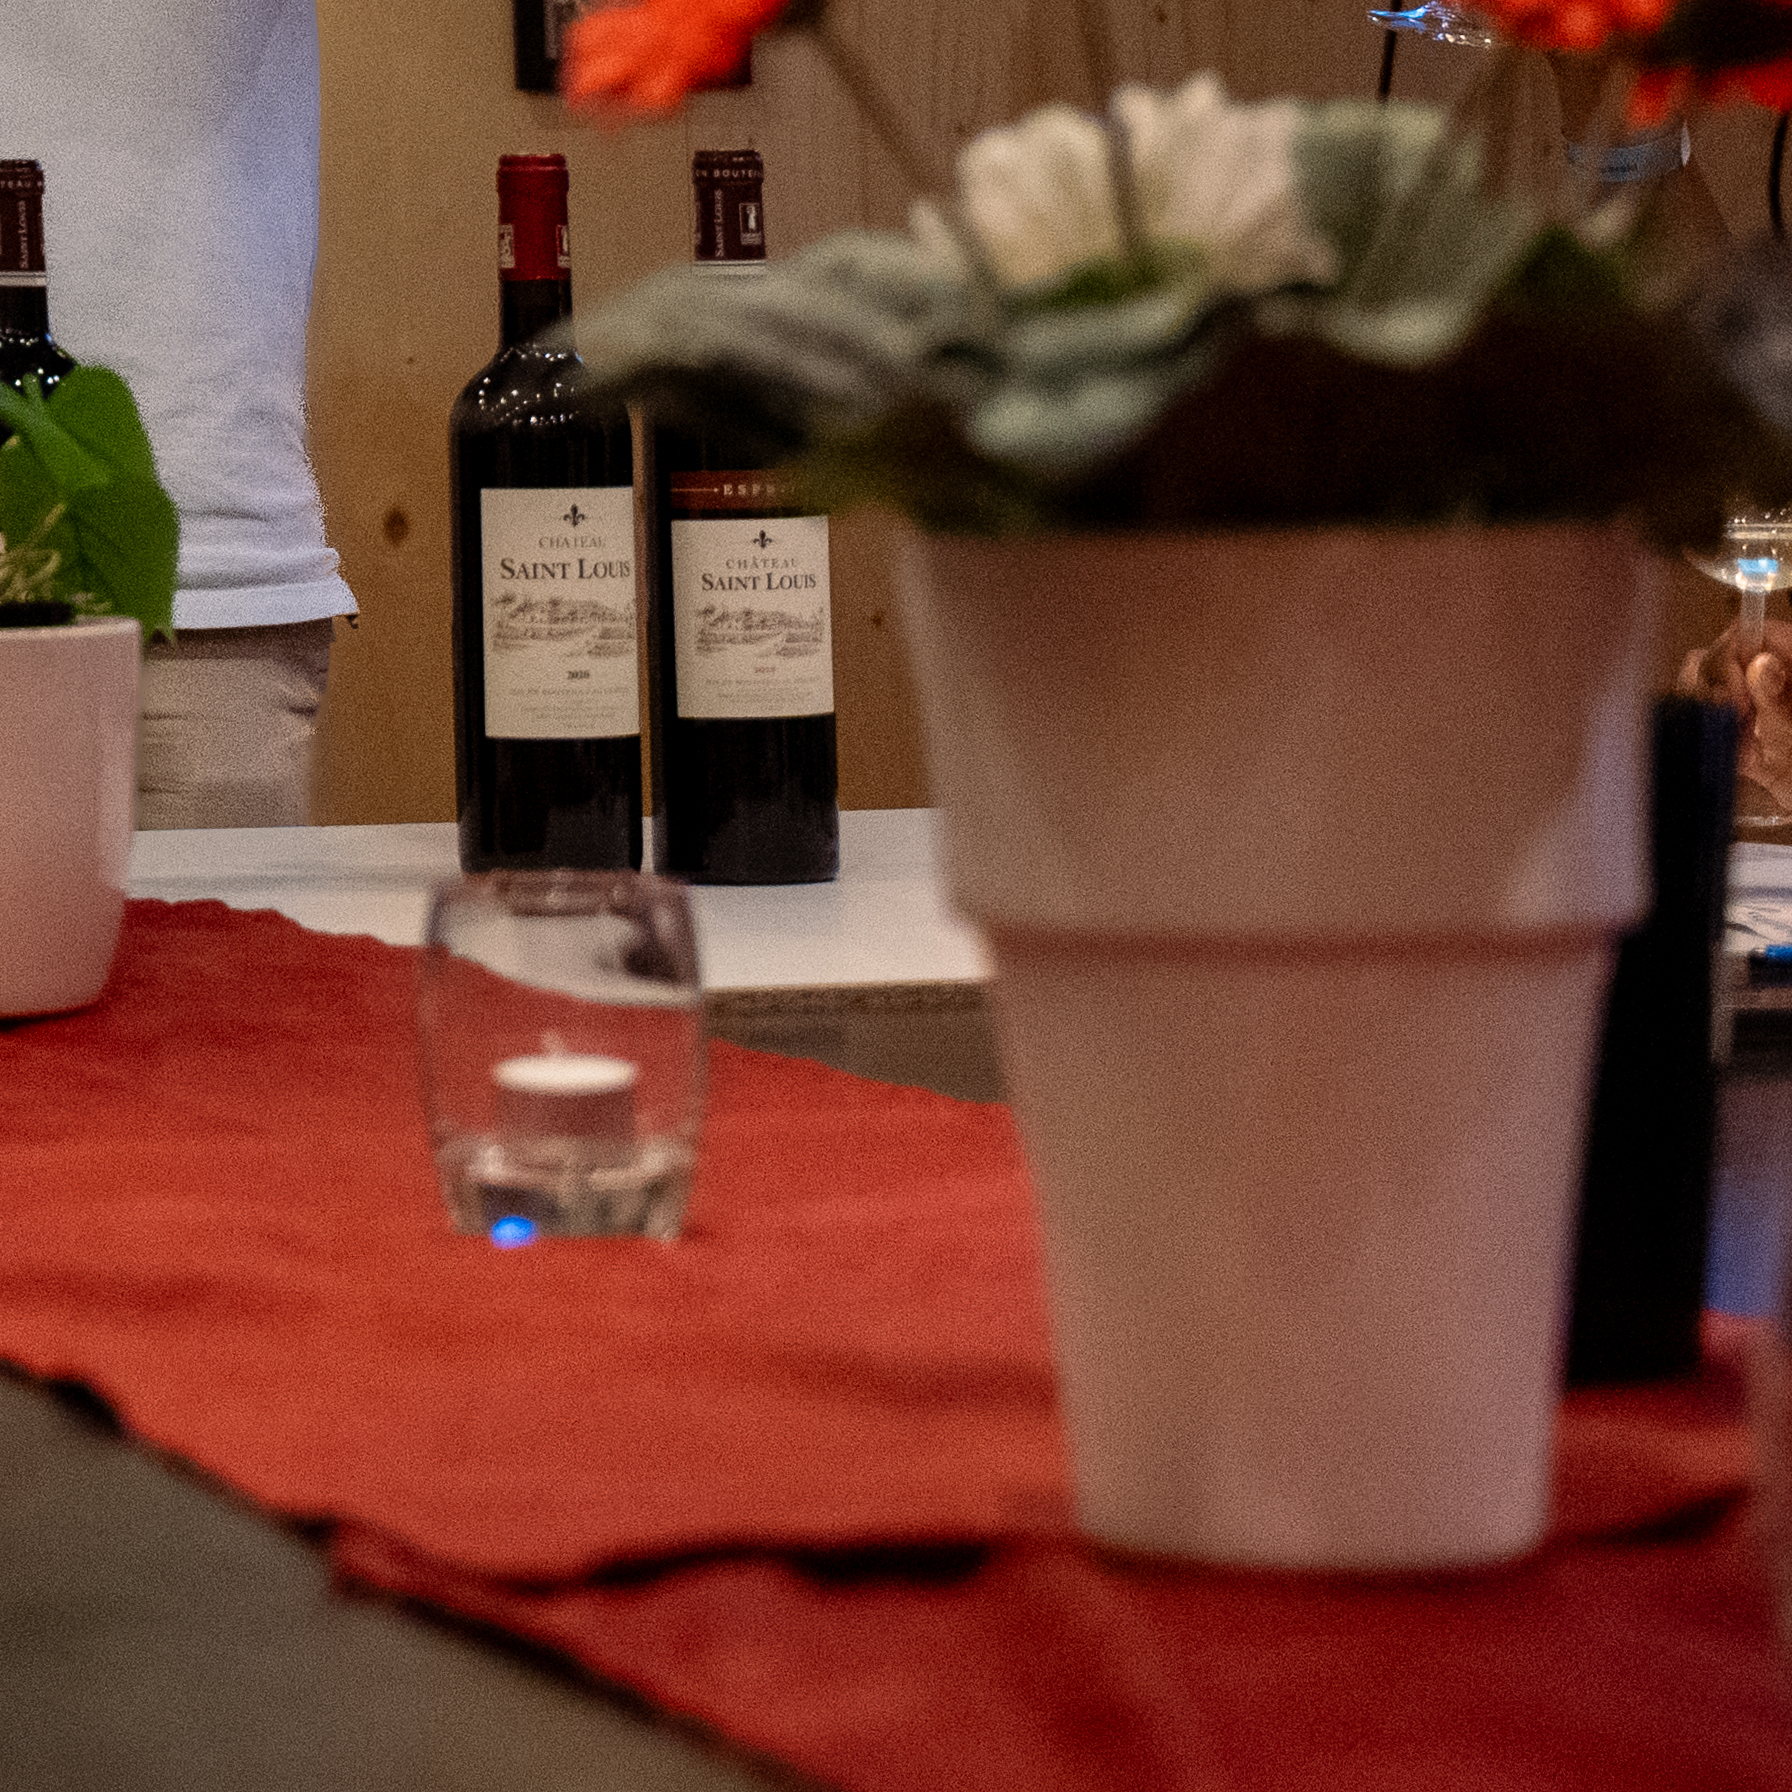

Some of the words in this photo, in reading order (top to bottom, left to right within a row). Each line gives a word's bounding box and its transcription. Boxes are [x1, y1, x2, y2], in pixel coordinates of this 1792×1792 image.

[500, 557, 571, 581] SAINT
[578, 558, 631, 580] LOUIS
[701, 572, 760, 592] SAINT
[766, 572, 817, 591] LOUIS
